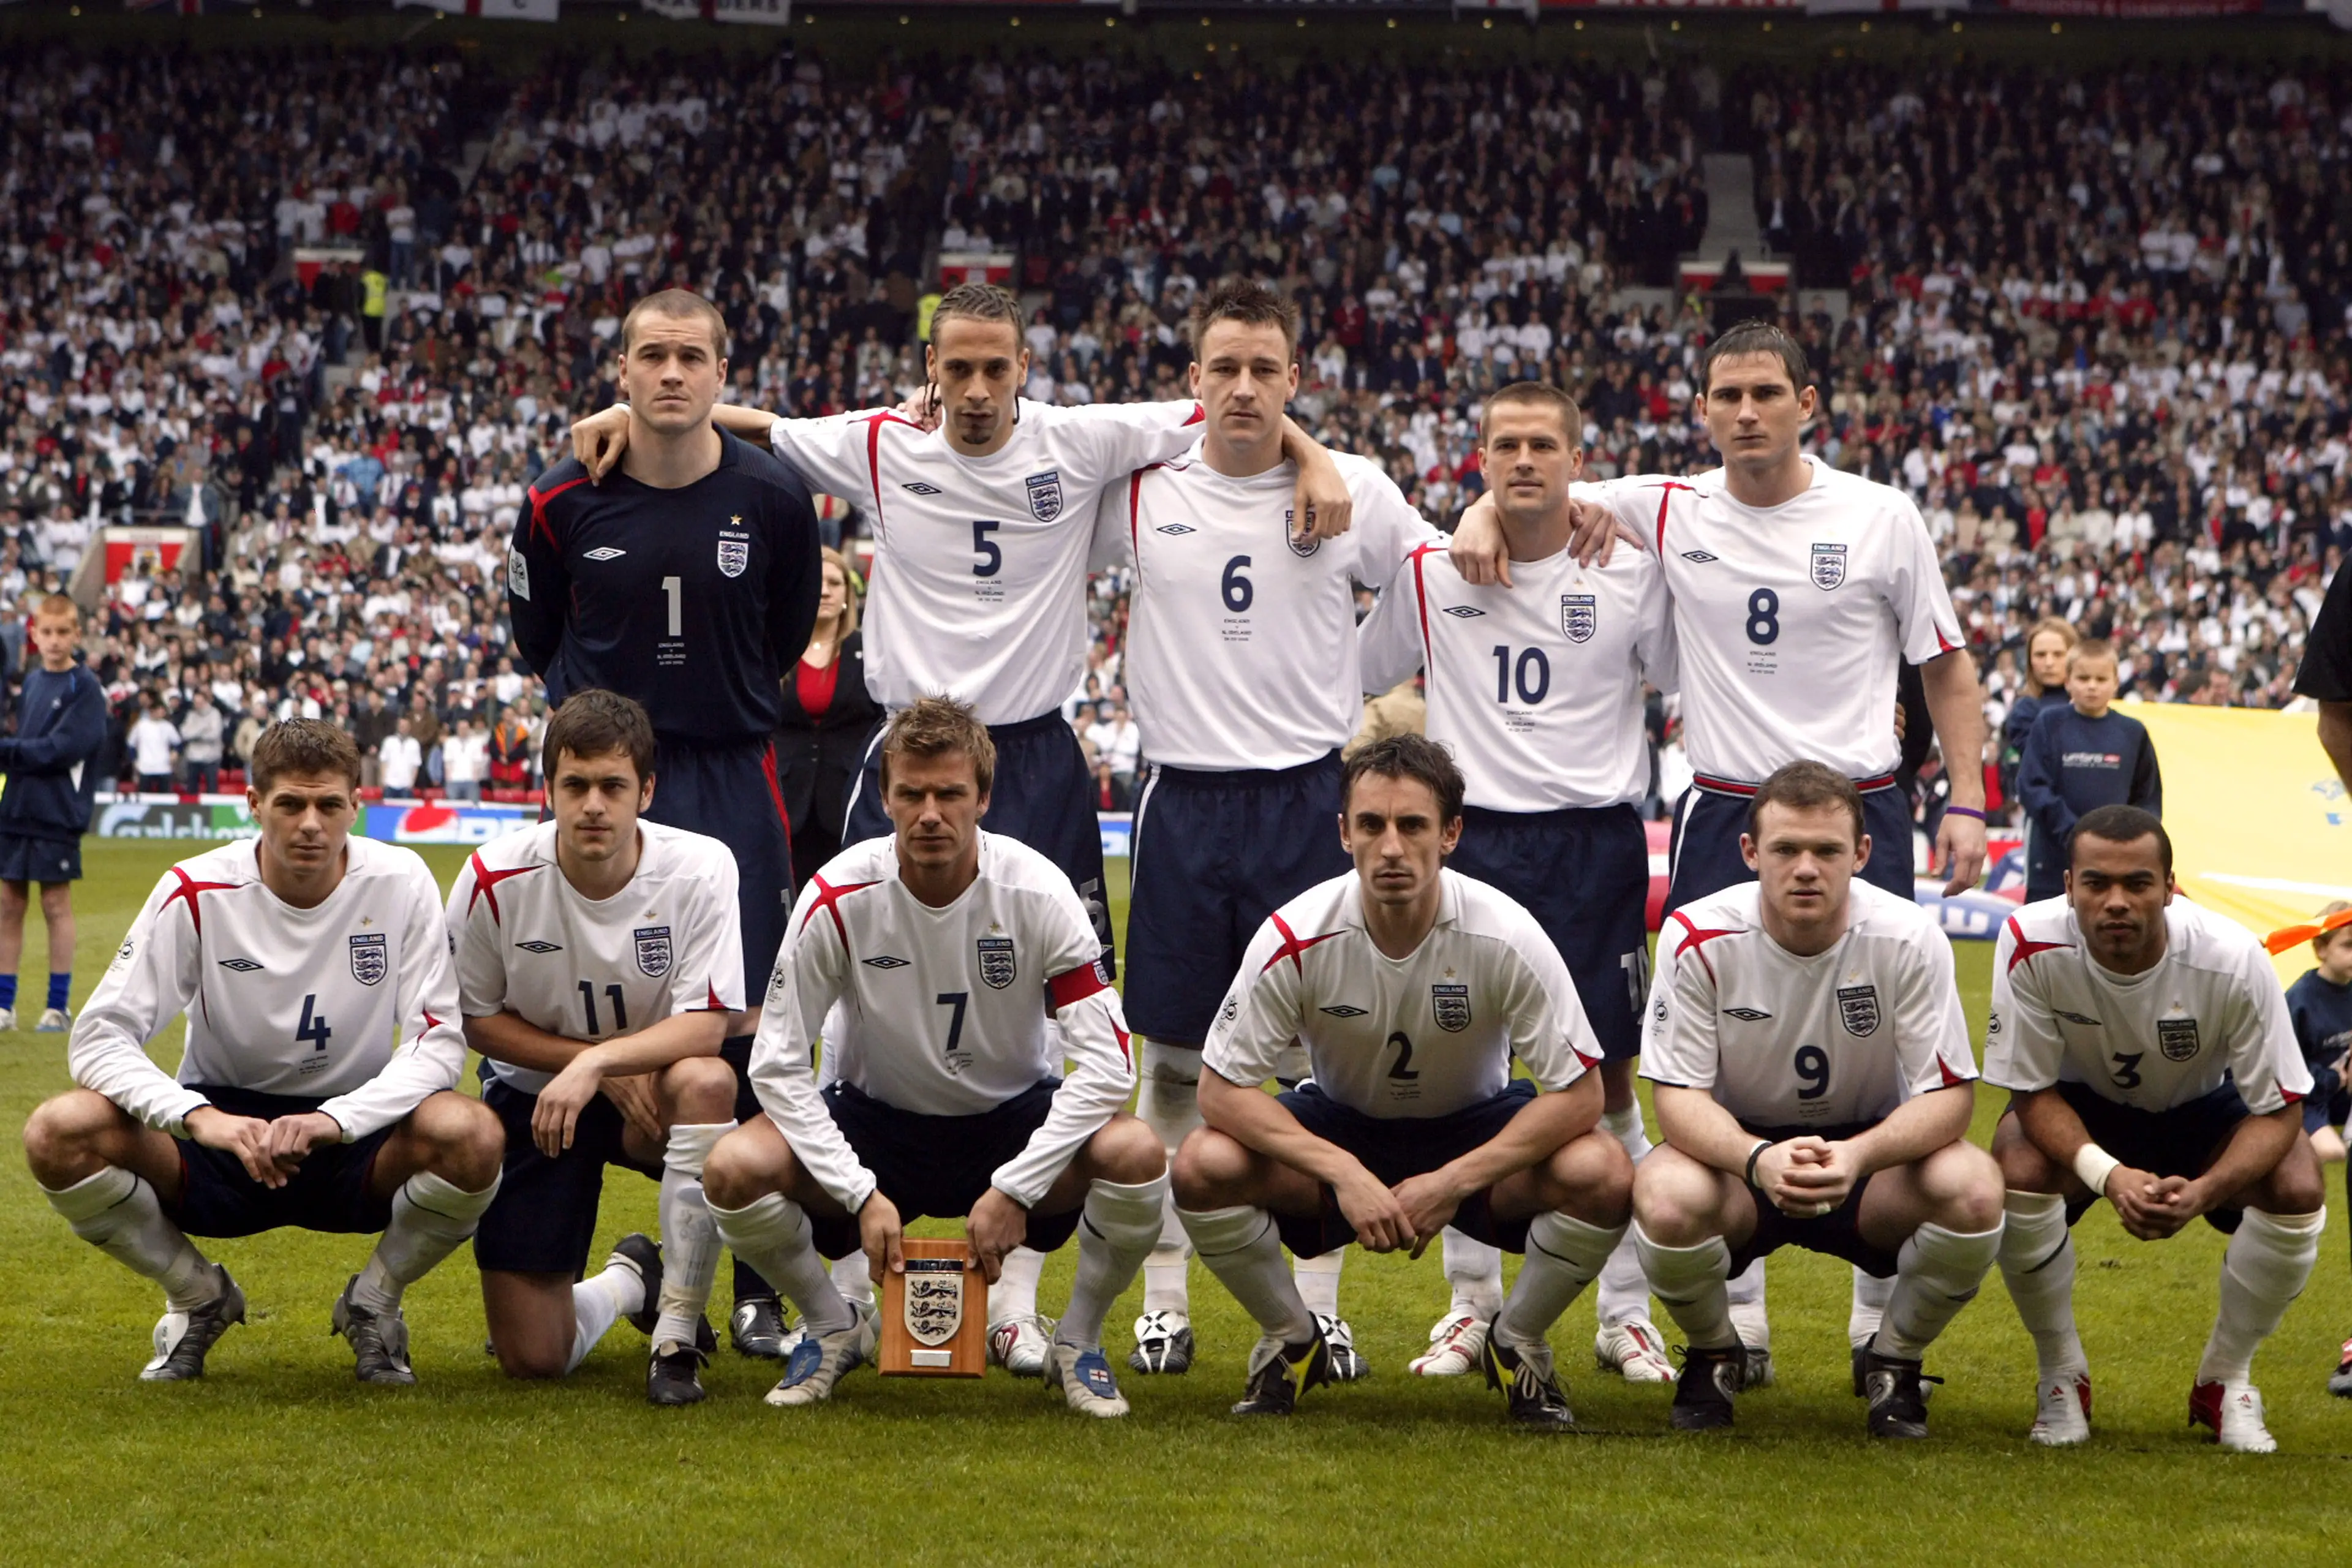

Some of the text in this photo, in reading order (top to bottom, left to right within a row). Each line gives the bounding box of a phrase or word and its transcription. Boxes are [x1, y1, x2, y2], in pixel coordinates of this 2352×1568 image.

[972, 521, 1001, 577] 5
[662, 576, 682, 636] 1
[1221, 555, 1253, 612] 6
[1746, 588, 1779, 645] 8
[1493, 645, 1550, 705] 10
[1080, 877, 1106, 939] 5
[296, 993, 331, 1051] 4
[578, 981, 627, 1035] 11
[937, 992, 968, 1051] 7
[1387, 1031, 1419, 1080] 2
[1795, 1045, 1830, 1099] 9
[2111, 1052, 2144, 1090] 3
